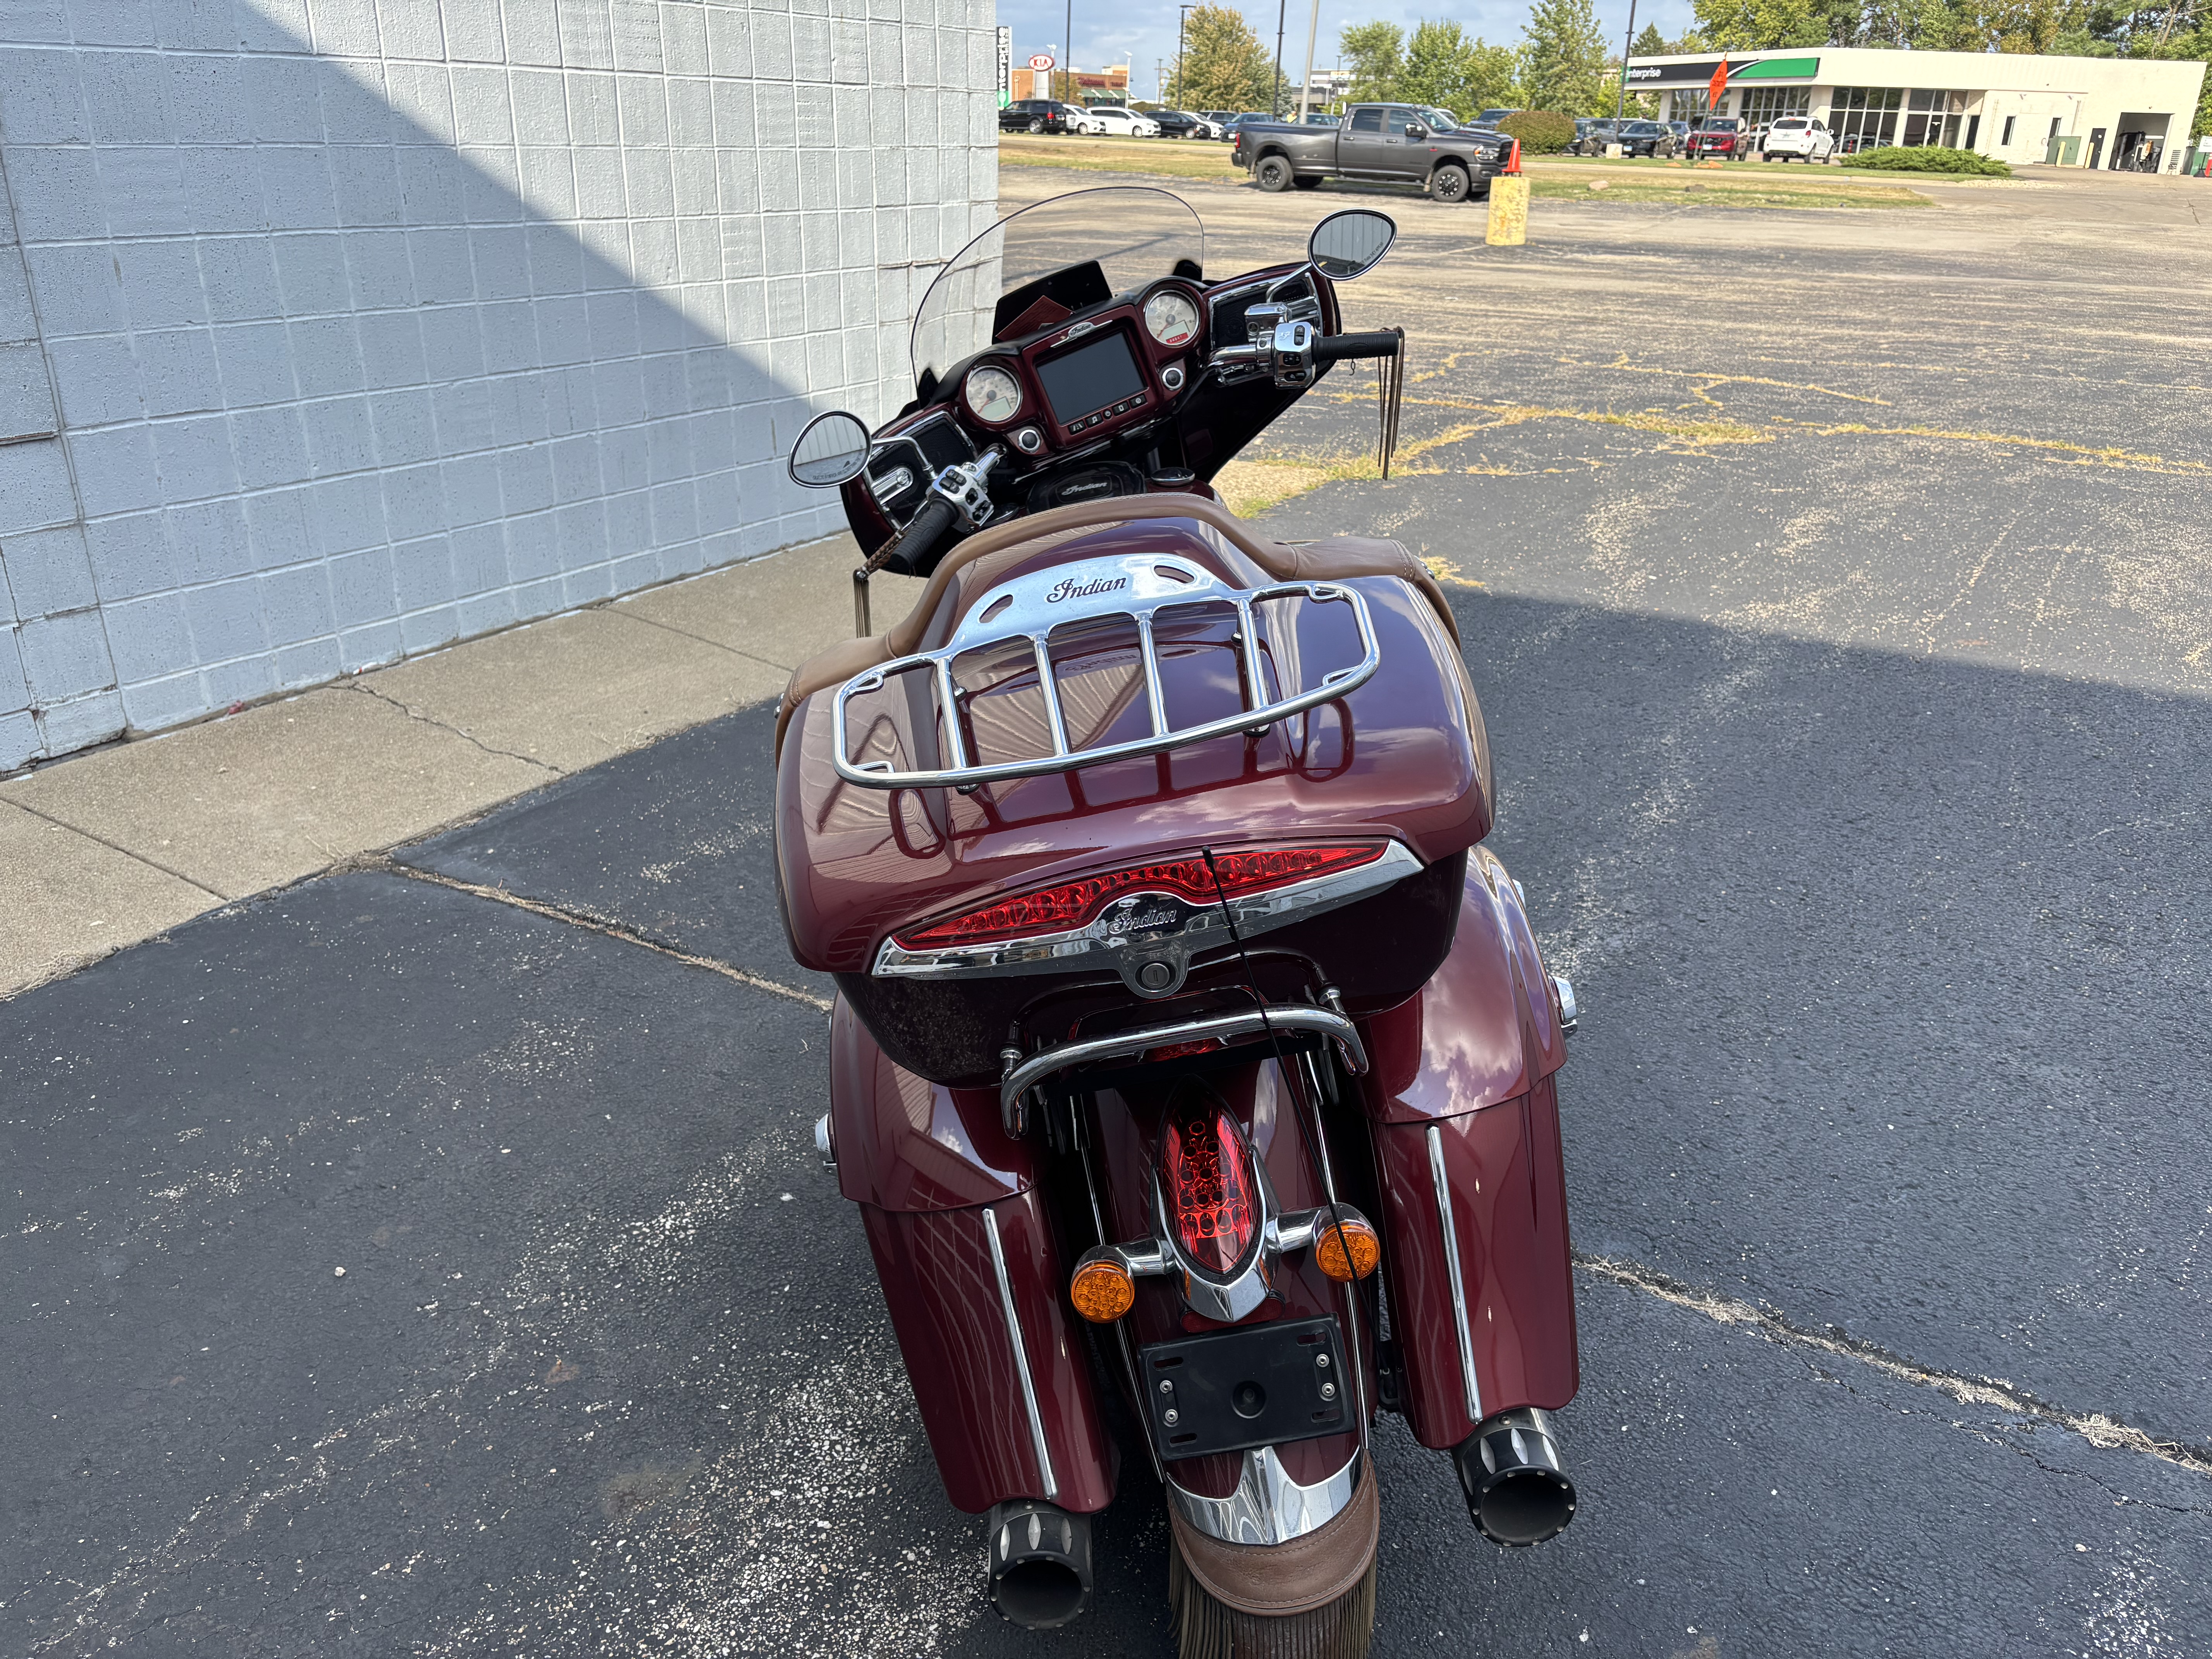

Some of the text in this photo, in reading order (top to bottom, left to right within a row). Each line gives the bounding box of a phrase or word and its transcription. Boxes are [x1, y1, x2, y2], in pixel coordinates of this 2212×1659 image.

[998, 27, 1008, 101] enterprise
[1033, 58, 1050, 67] KIA
[1626, 67, 1661, 80] enterprise
[1070, 324, 1091, 336] Indian
[1061, 483, 1108, 495] Indian
[1046, 577, 1127, 603] Indian
[1108, 908, 1177, 934] Indian
